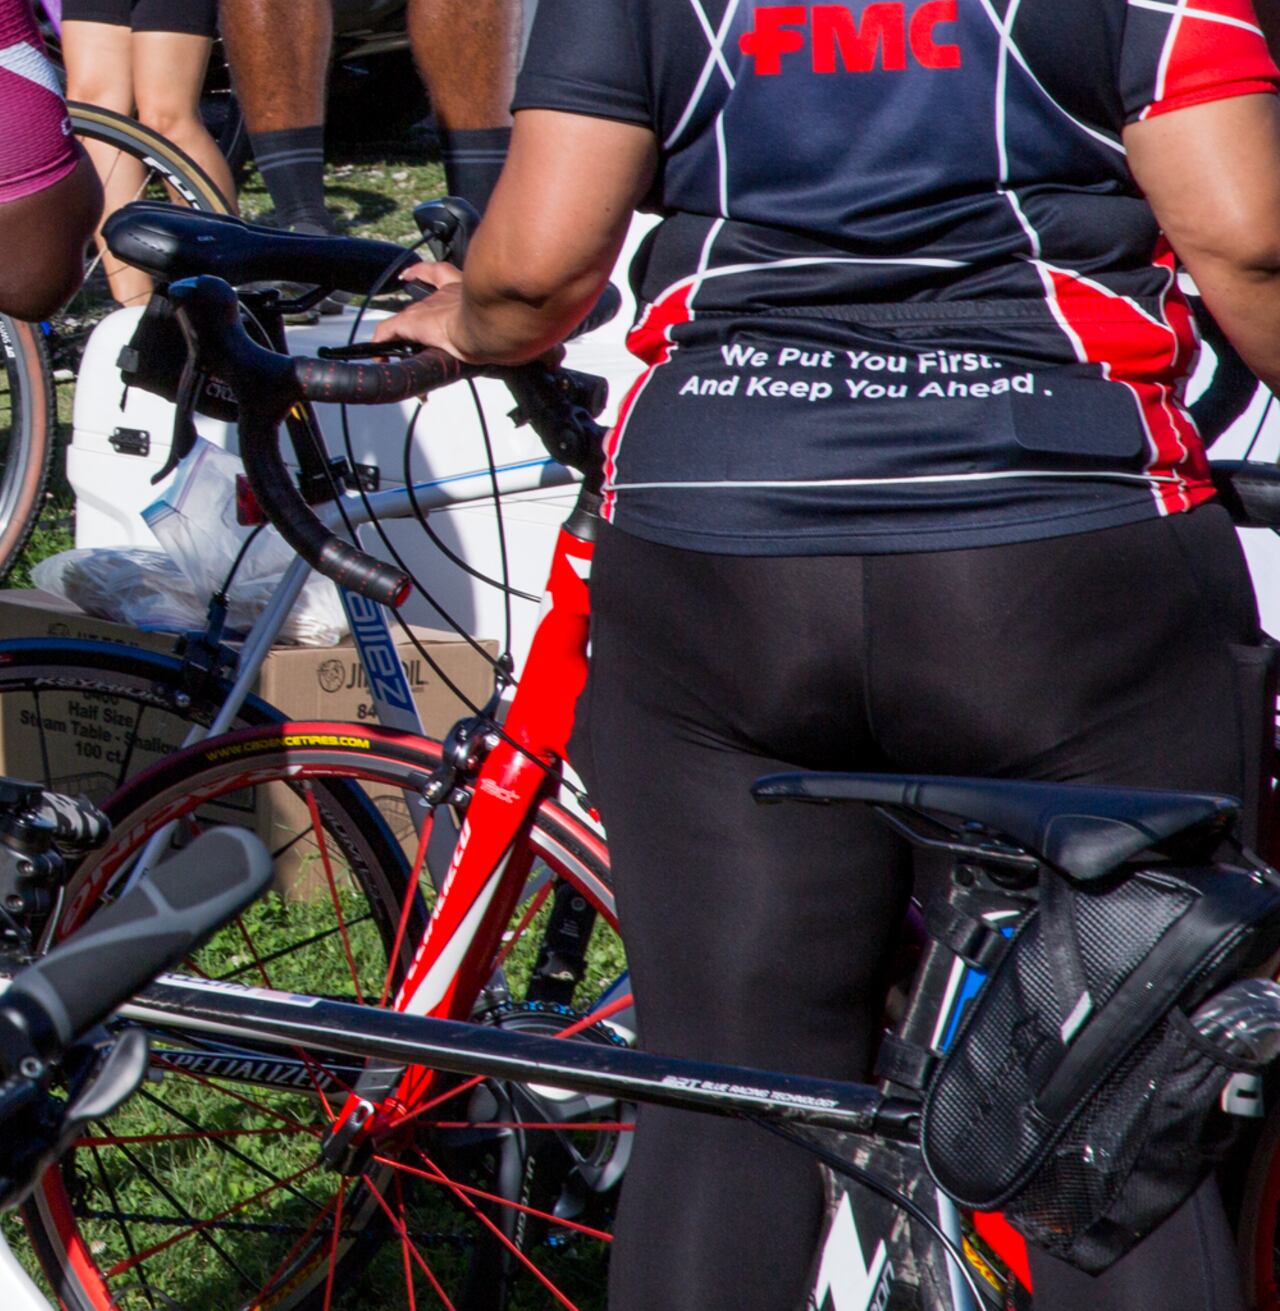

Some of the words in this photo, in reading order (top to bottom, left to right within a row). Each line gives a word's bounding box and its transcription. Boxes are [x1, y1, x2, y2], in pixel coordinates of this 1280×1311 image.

[721, 344, 769, 368] We
[778, 348, 834, 368] Put
[846, 350, 906, 373] You
[679, 375, 739, 397] And
[746, 376, 833, 402] Keep
[845, 378, 907, 399] You
[68, 700, 99, 720] Half
[103, 706, 134, 729] Size
[71, 720, 113, 743] Table
[75, 741, 102, 758] 100
